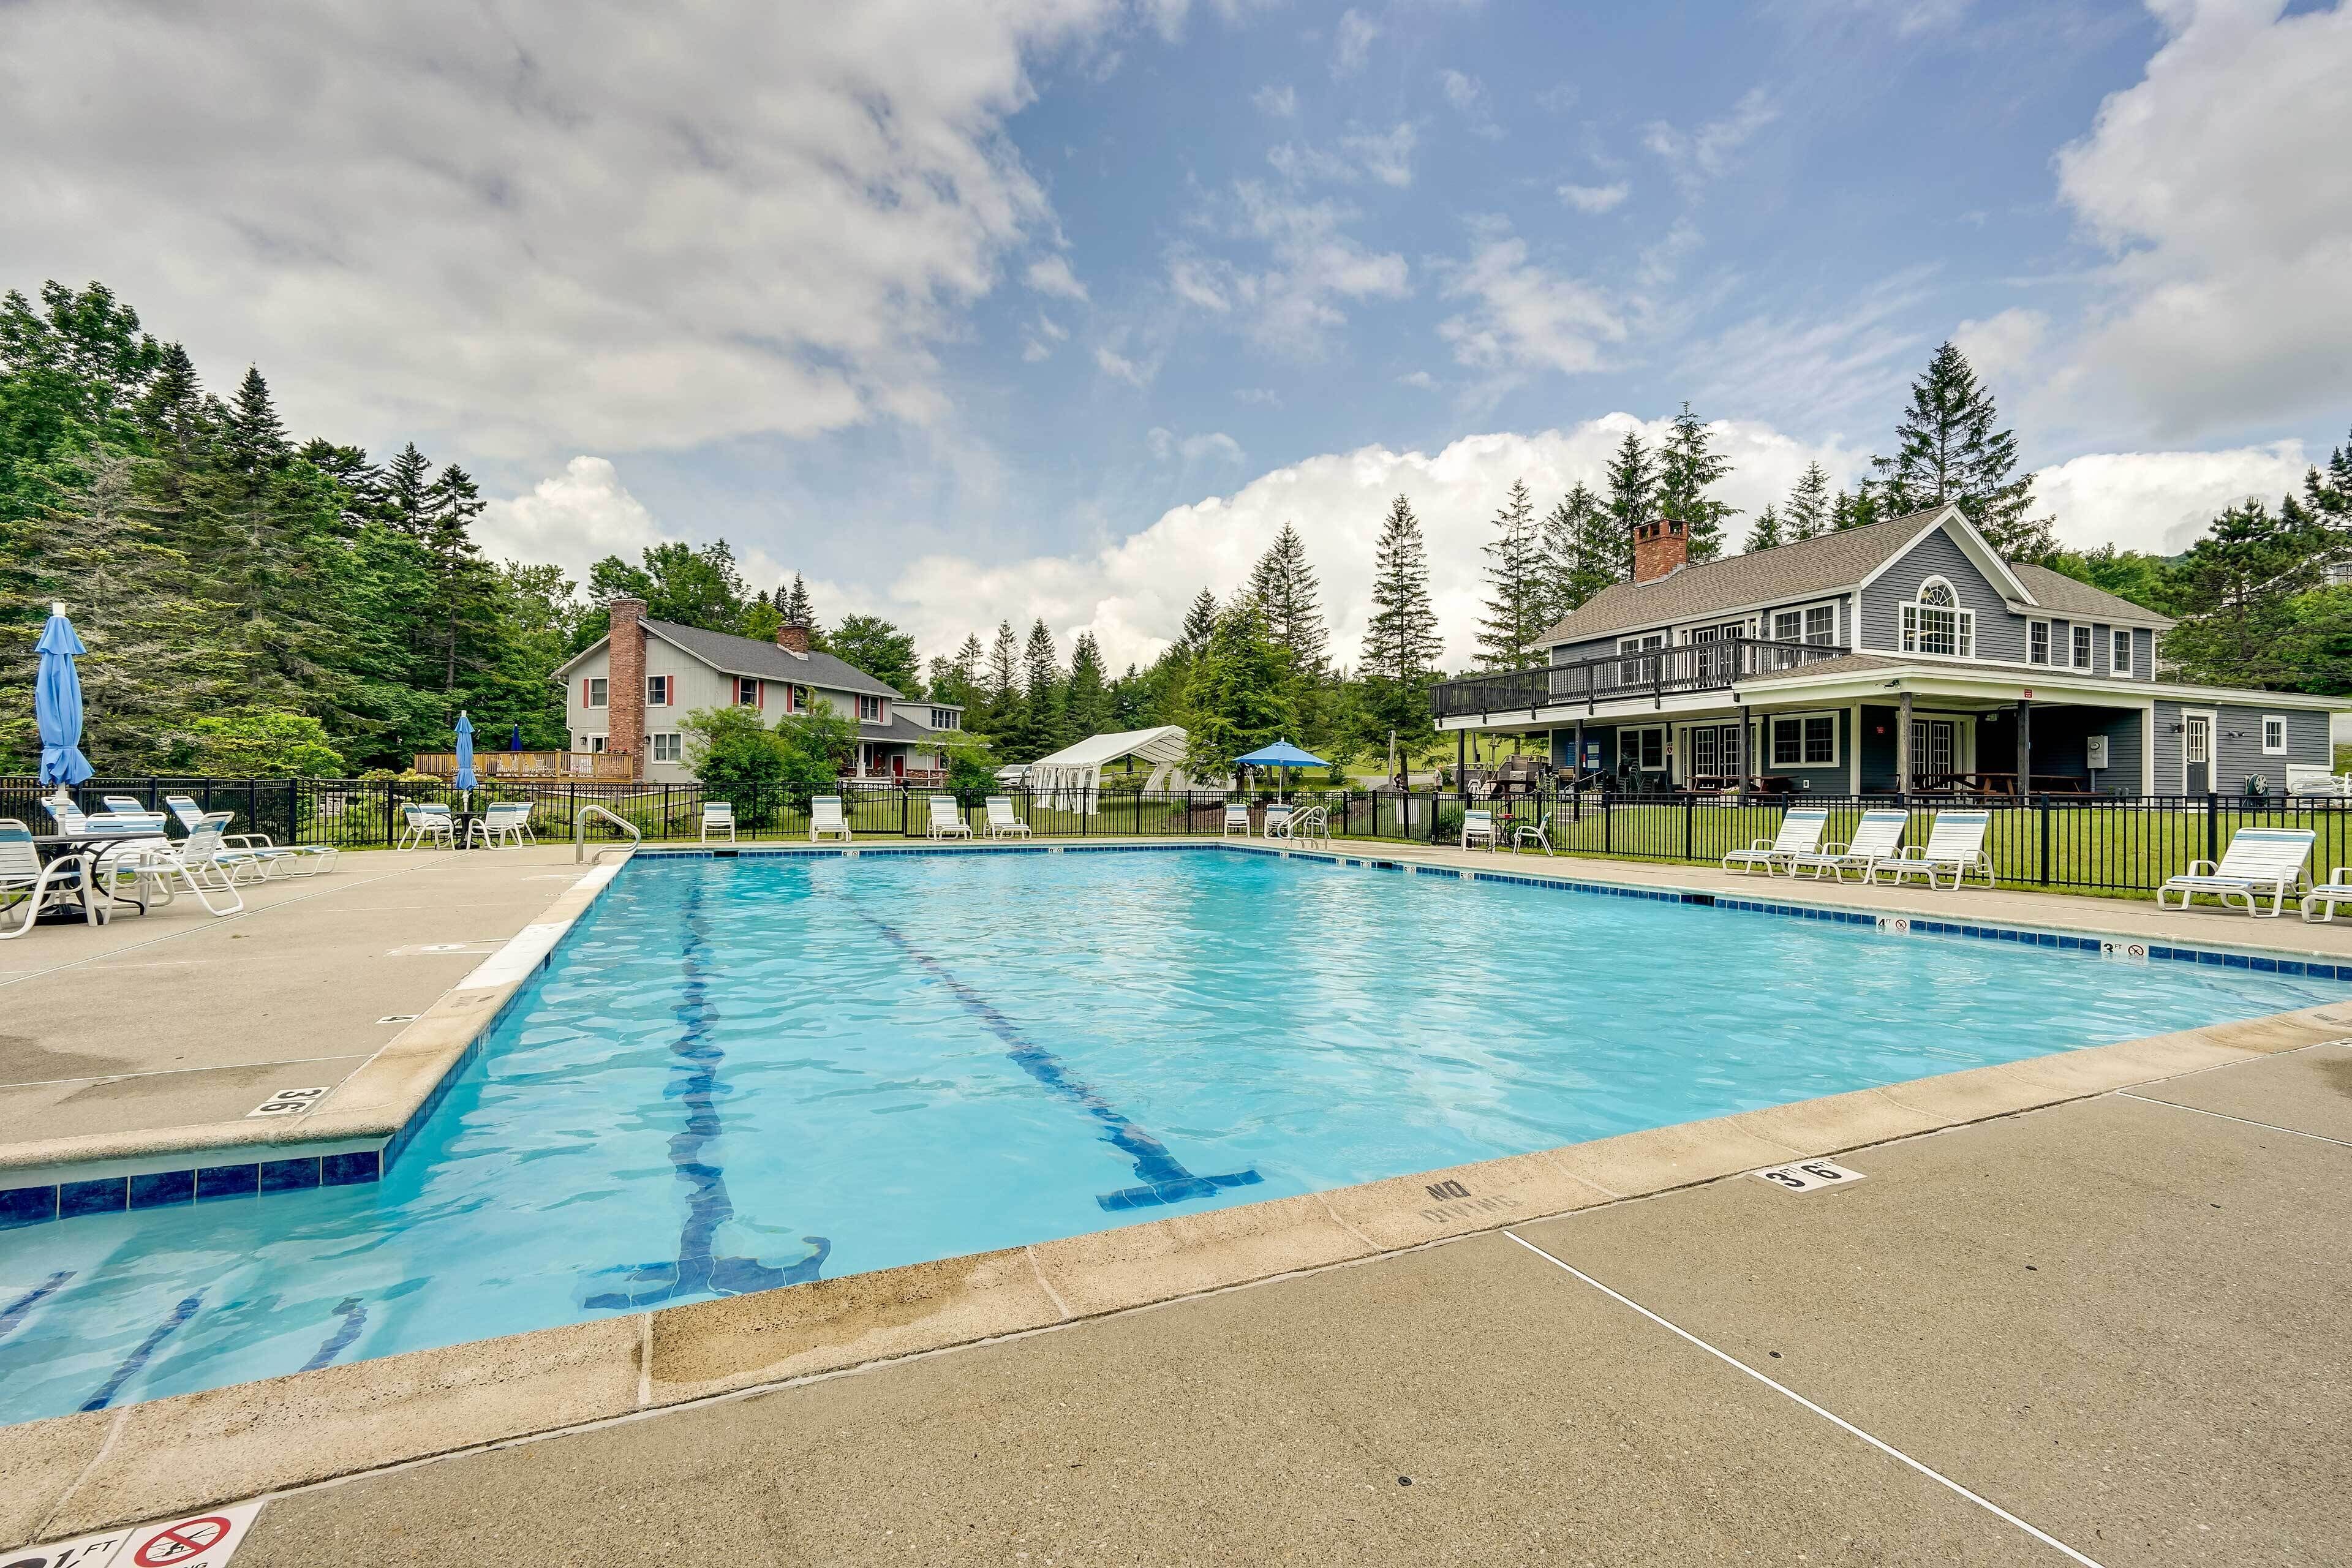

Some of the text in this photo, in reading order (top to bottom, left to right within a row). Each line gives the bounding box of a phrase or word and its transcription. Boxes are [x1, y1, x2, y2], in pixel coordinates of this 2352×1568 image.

[1765, 1173, 1806, 1188] 3
[1801, 1165, 1842, 1180] 6
[1425, 1179, 1471, 1202] NO
[82, 1539, 118, 1556] FT
